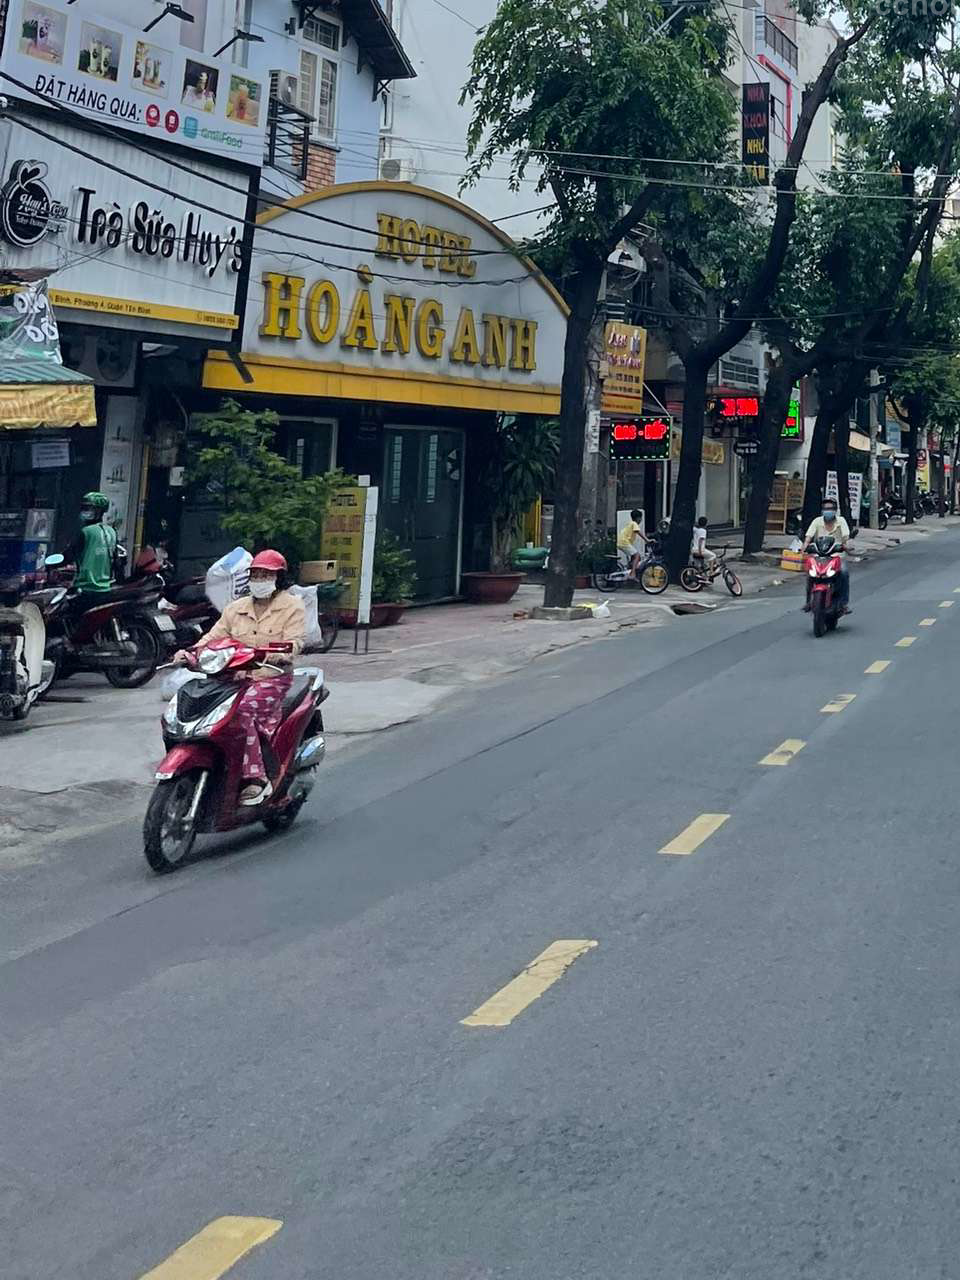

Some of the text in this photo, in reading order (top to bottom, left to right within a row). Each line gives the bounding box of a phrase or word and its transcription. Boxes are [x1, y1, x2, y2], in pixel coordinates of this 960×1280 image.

[67, 82, 106, 110] HÀNG
[178, 211, 244, 278] Huy's
[375, 211, 478, 279] HOTEL
[260, 264, 447, 359] HOÀNG
[450, 307, 538, 371] ANH
